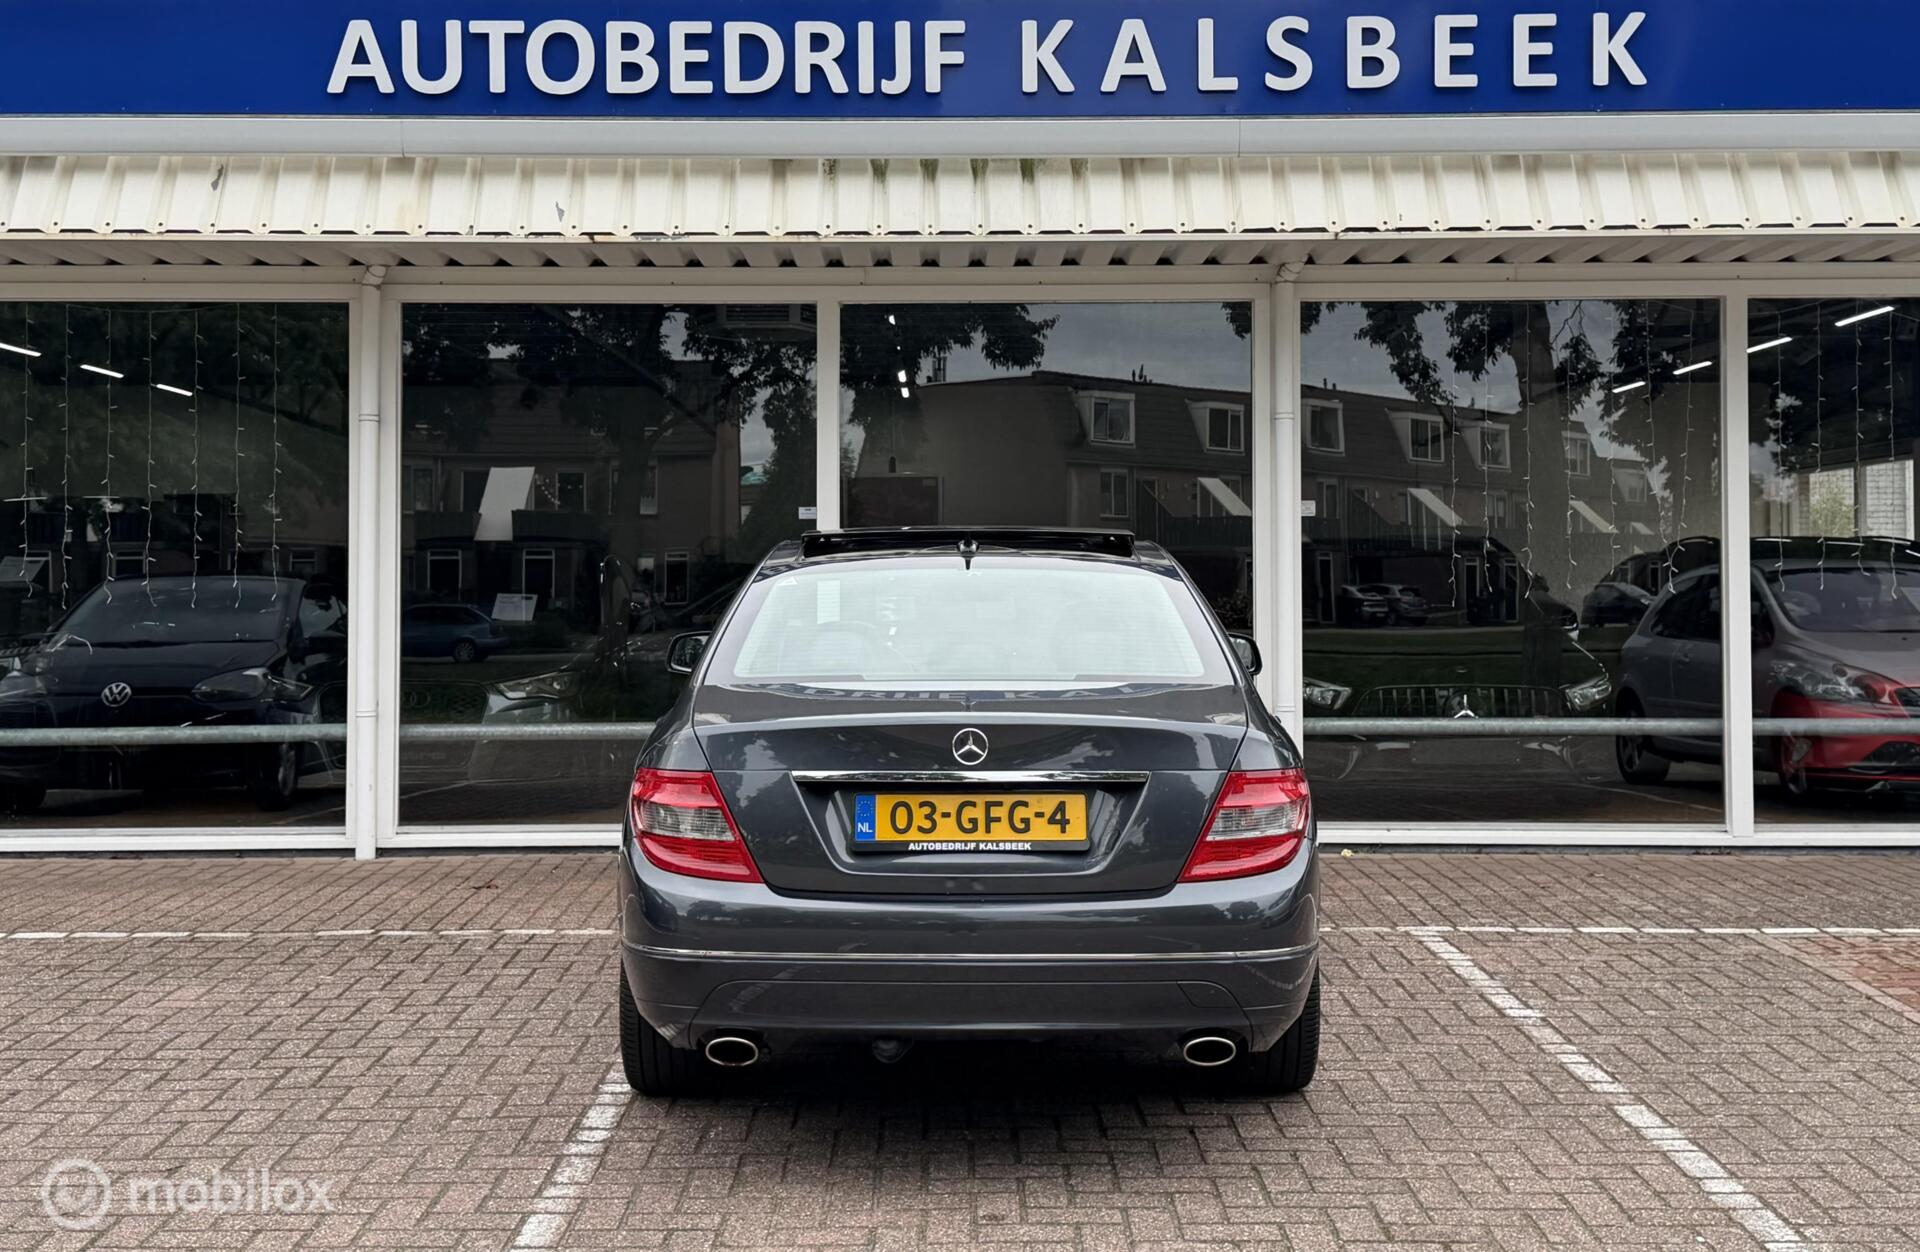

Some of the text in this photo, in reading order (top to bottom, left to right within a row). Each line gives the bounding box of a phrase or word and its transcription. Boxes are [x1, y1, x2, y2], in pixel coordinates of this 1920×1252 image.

[327, 11, 1647, 95] AUTOBEDRIJF KALSBEEK
[857, 821, 873, 833] NL
[889, 800, 1071, 835] 03-GFG-4
[908, 842, 1032, 851] AUTOBEDRIJF KALSBEEK
